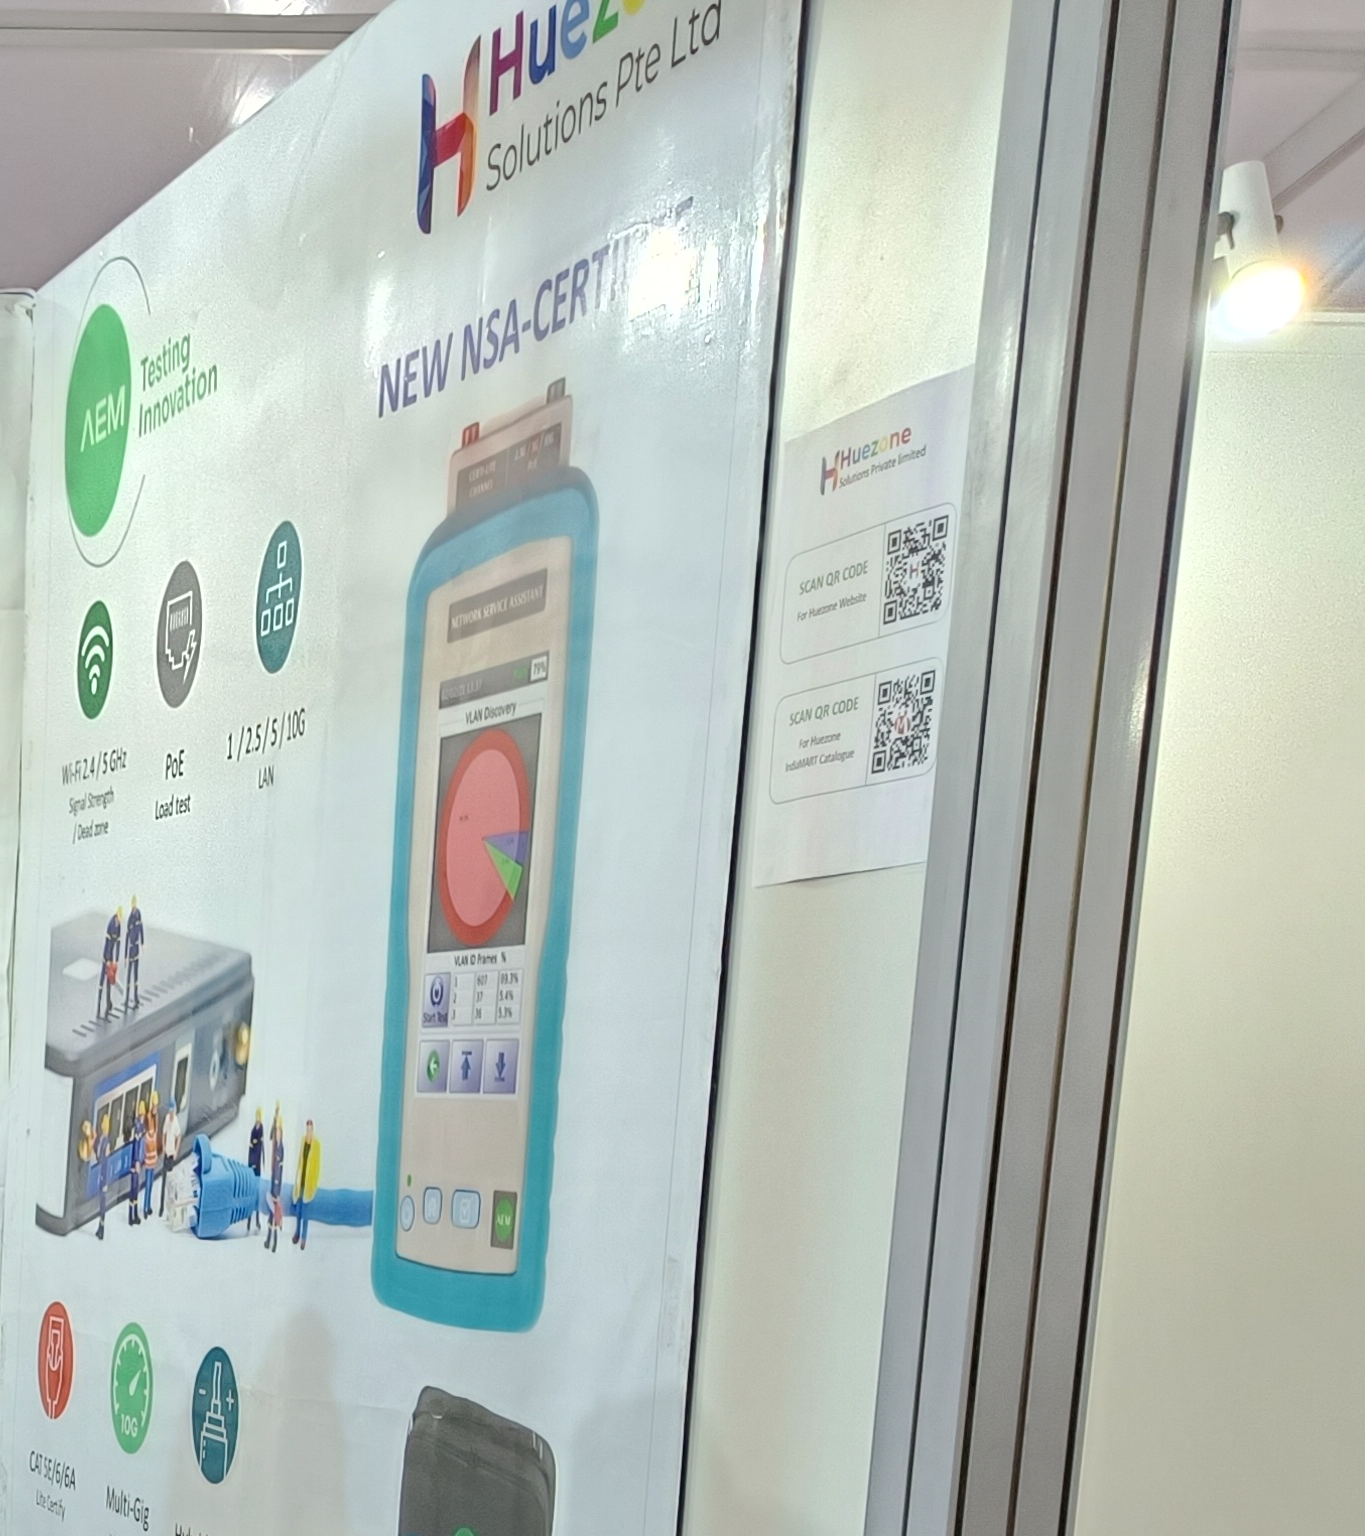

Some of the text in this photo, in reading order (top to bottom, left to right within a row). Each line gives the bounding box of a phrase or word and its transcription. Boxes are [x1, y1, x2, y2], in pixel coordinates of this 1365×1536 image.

[486, 0, 722, 191] Solutions Pte Ltd
[140, 333, 191, 392] Testing
[378, 332, 453, 417] NEW
[80, 385, 126, 452] AEM
[138, 364, 218, 438] Innovation
[840, 427, 912, 471] Huezone
[839, 464, 869, 489] Solutions
[871, 456, 897, 479] Private
[799, 560, 869, 595] SCAN QR CODE
[797, 592, 867, 622] For Huezone Website
[465, 701, 517, 726] VLAN Discovery
[165, 749, 185, 780] PoE
[258, 765, 275, 790] LAN
[155, 794, 191, 821] Load test
[106, 1485, 150, 1532] Multi-Gig
